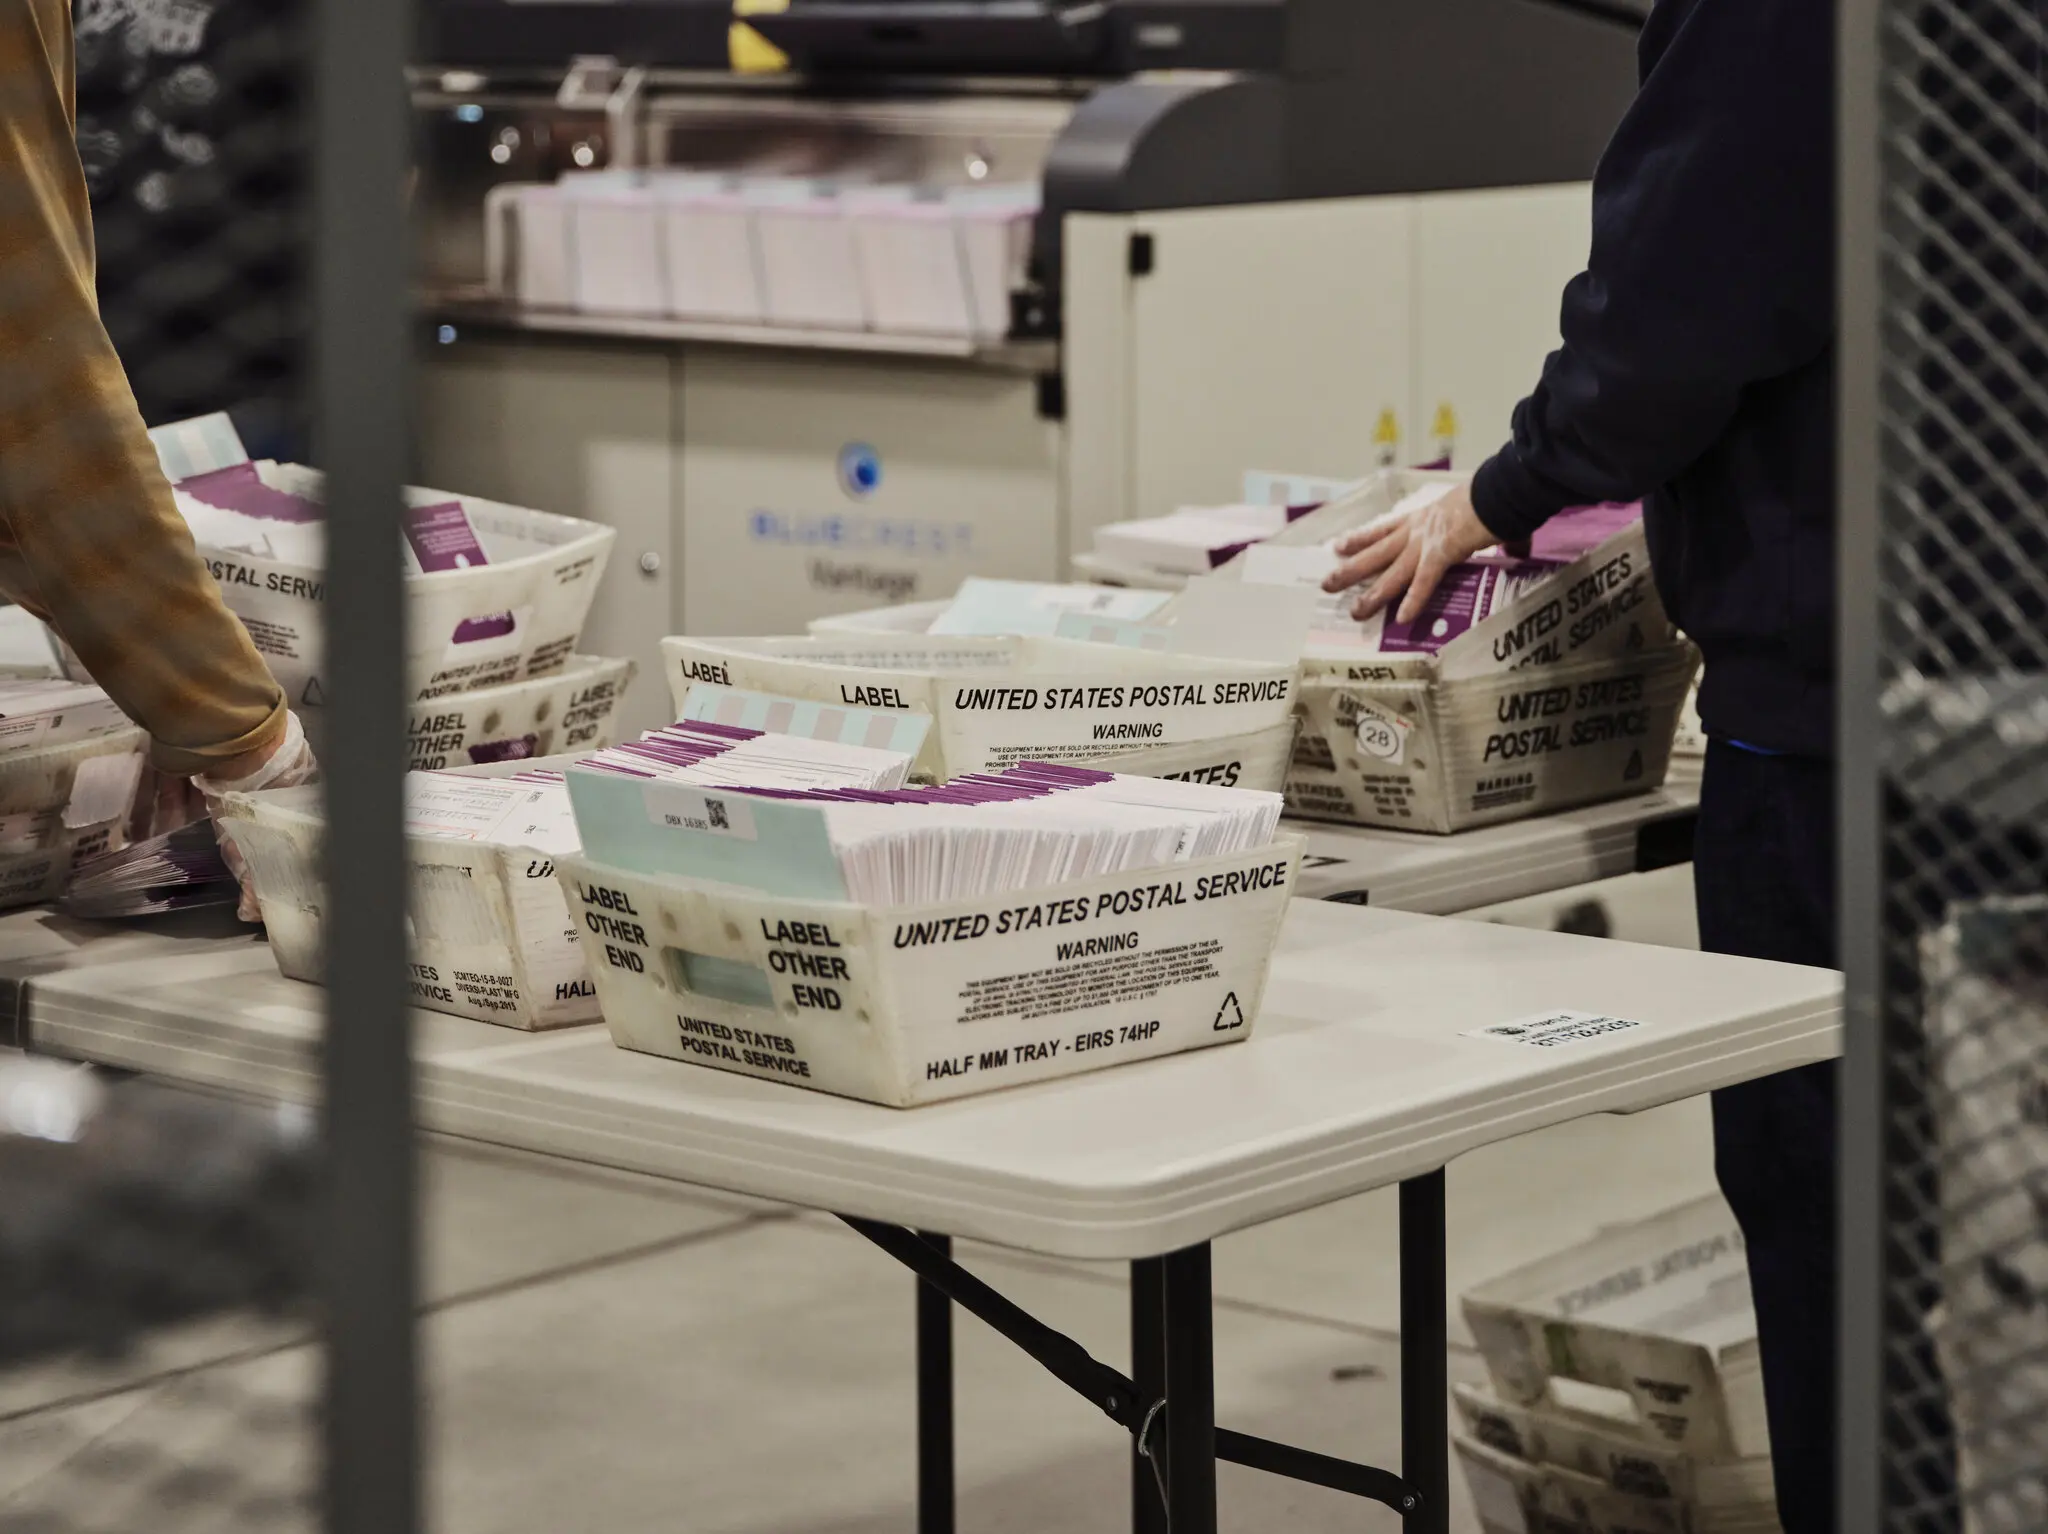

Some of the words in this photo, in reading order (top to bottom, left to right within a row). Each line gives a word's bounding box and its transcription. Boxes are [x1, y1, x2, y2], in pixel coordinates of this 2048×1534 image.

[266, 573, 324, 601] SERVI
[1493, 600, 1563, 662] UNITED
[1566, 553, 1633, 614] STATES
[681, 658, 733, 686] LABEL
[841, 684, 909, 709] LABEL
[954, 688, 1038, 711] UNITED
[1043, 686, 1125, 709] STATES
[1129, 684, 1207, 707] POSTAL
[1212, 679, 1288, 705] SERVICE
[1093, 723, 1163, 740] WARNING
[1366, 726, 1390, 748] 28
[1483, 723, 1563, 763] POSTAL
[578, 882, 638, 915] LABEL
[893, 913, 989, 948] UNITED
[995, 897, 1091, 935] STATES
[1095, 882, 1187, 919] POSTAL
[1193, 861, 1288, 901] SERVICE
[585, 913, 649, 947] OTHER
[761, 918, 841, 947] LABEL
[605, 943, 644, 973] END
[1057, 931, 1139, 961] WARNING
[768, 950, 850, 981] OTHER
[792, 984, 841, 1010] END
[677, 1015, 732, 1043] UNITED
[735, 1029, 796, 1054] STATES
[680, 1035, 741, 1063] POSTAL
[744, 1051, 811, 1078] SERVICE
[926, 1055, 973, 1081] HALF
[979, 1049, 1008, 1070] MM
[1014, 1040, 1060, 1064] TRAY
[1075, 1030, 1114, 1053] EIRS
[1119, 1020, 1161, 1045] 74HP
